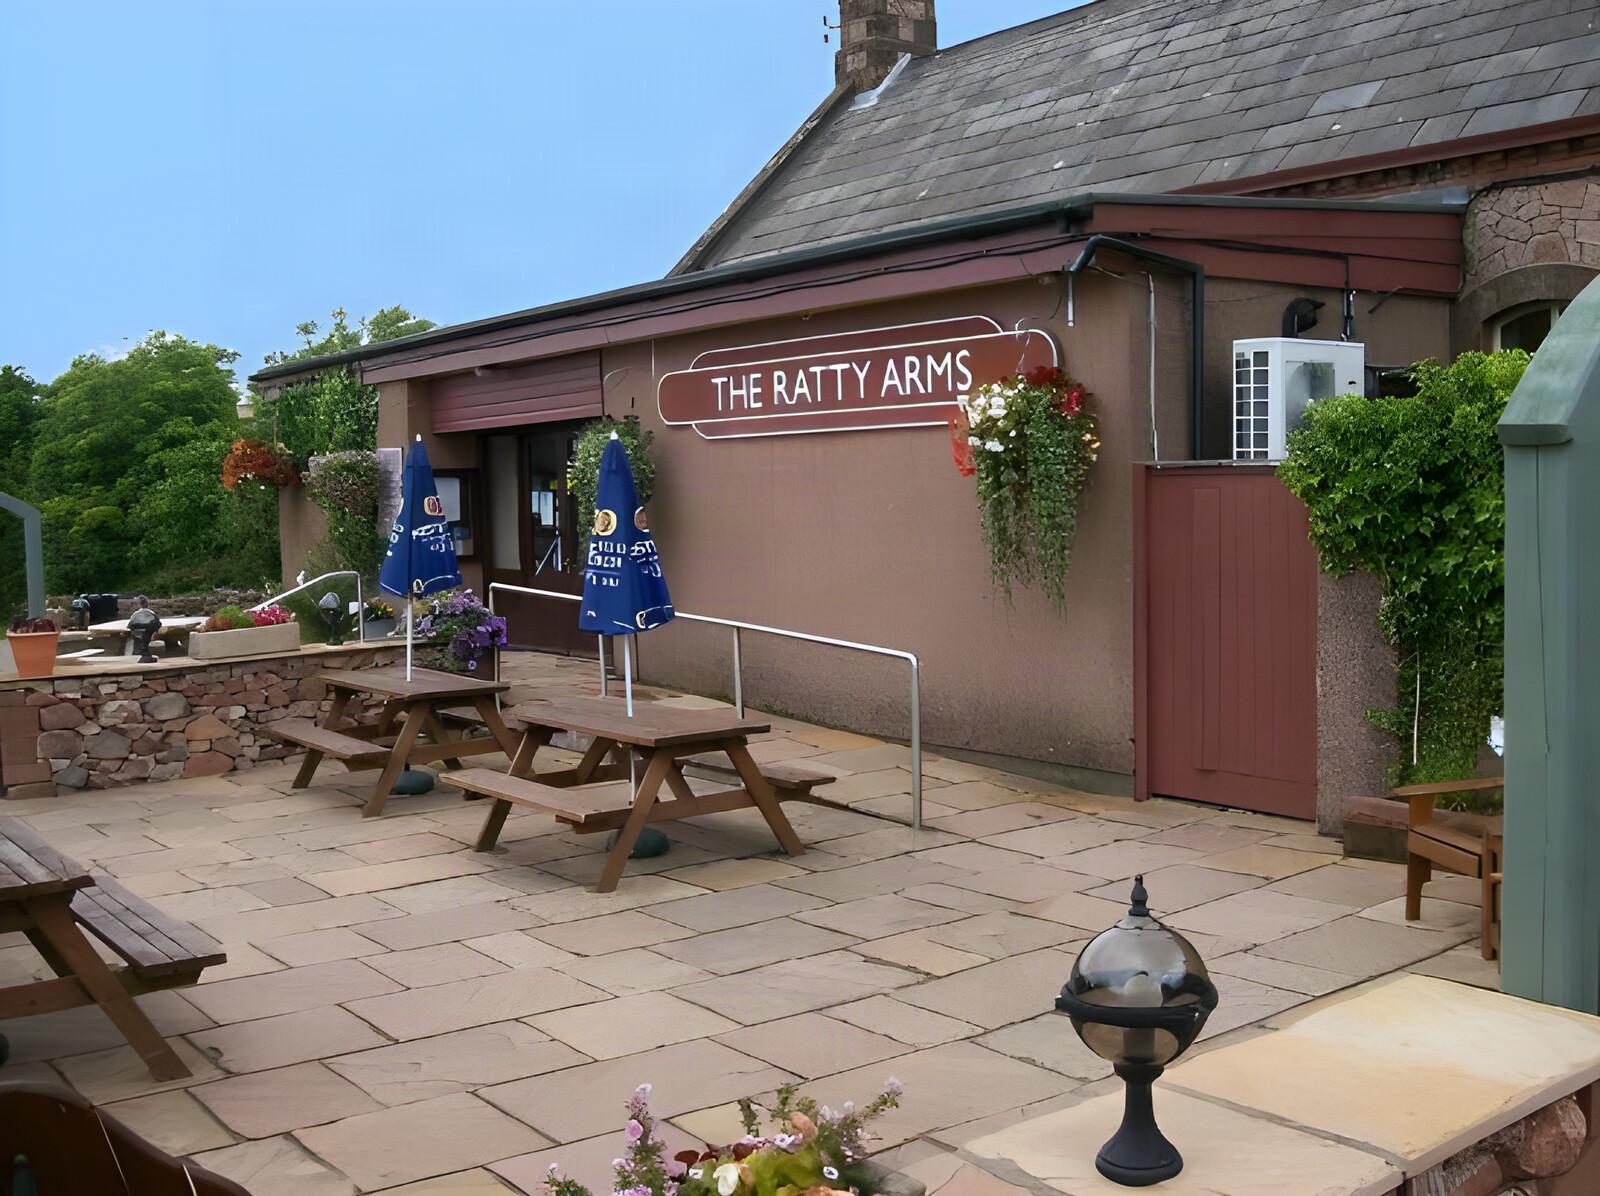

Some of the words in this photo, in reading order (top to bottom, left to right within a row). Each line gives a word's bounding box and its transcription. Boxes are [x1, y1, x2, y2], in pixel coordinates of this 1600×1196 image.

[711, 372, 763, 411] THE
[773, 360, 871, 405] RATTY
[880, 349, 973, 398] ARMS
